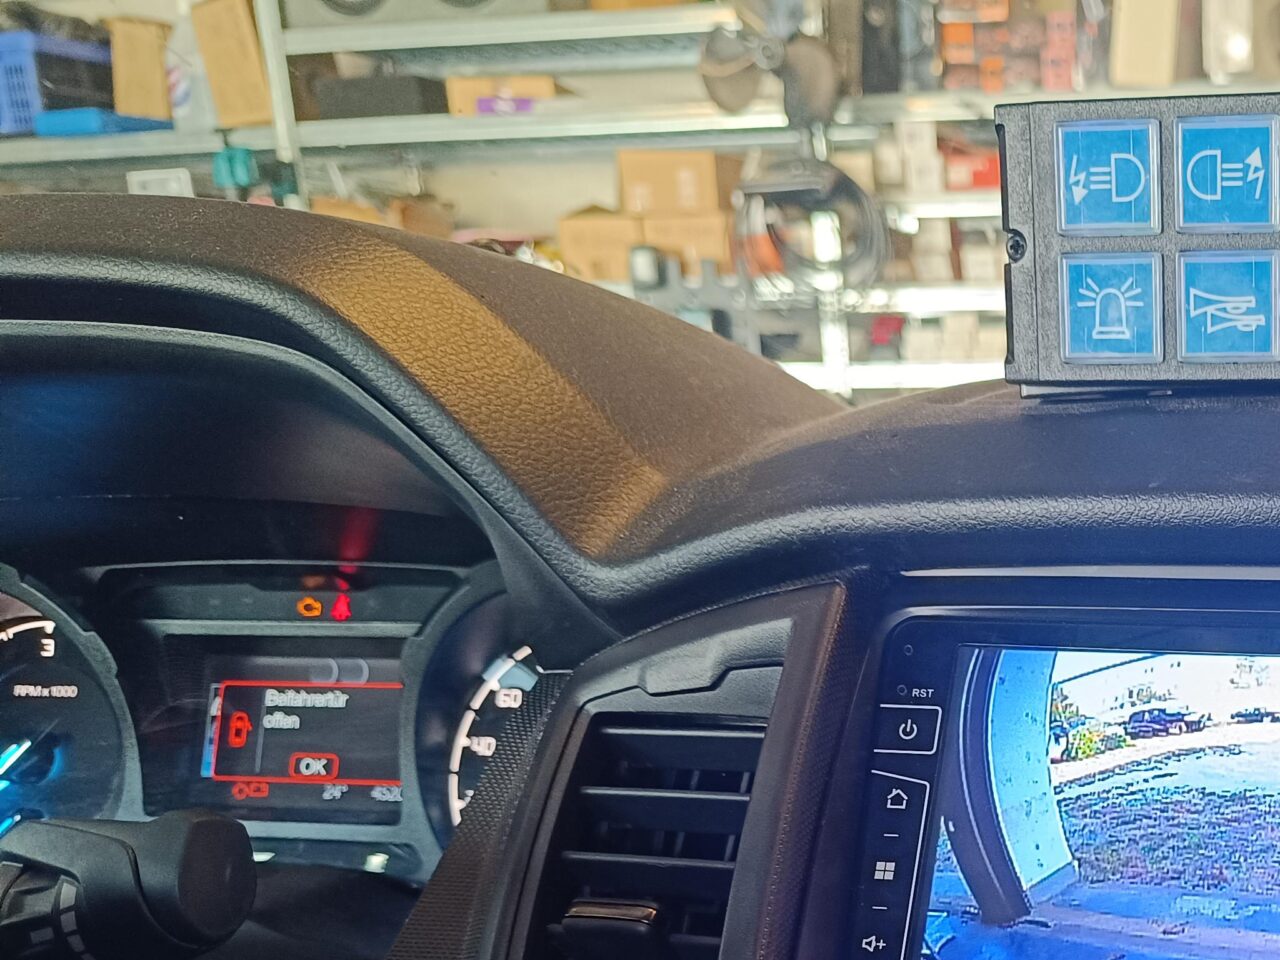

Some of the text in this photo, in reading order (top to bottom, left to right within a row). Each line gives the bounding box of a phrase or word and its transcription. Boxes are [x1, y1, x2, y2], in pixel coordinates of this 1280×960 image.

[40, 638, 56, 658] 3
[495, 688, 523, 709] 60
[912, 688, 935, 698] RST
[299, 757, 329, 776] OK
